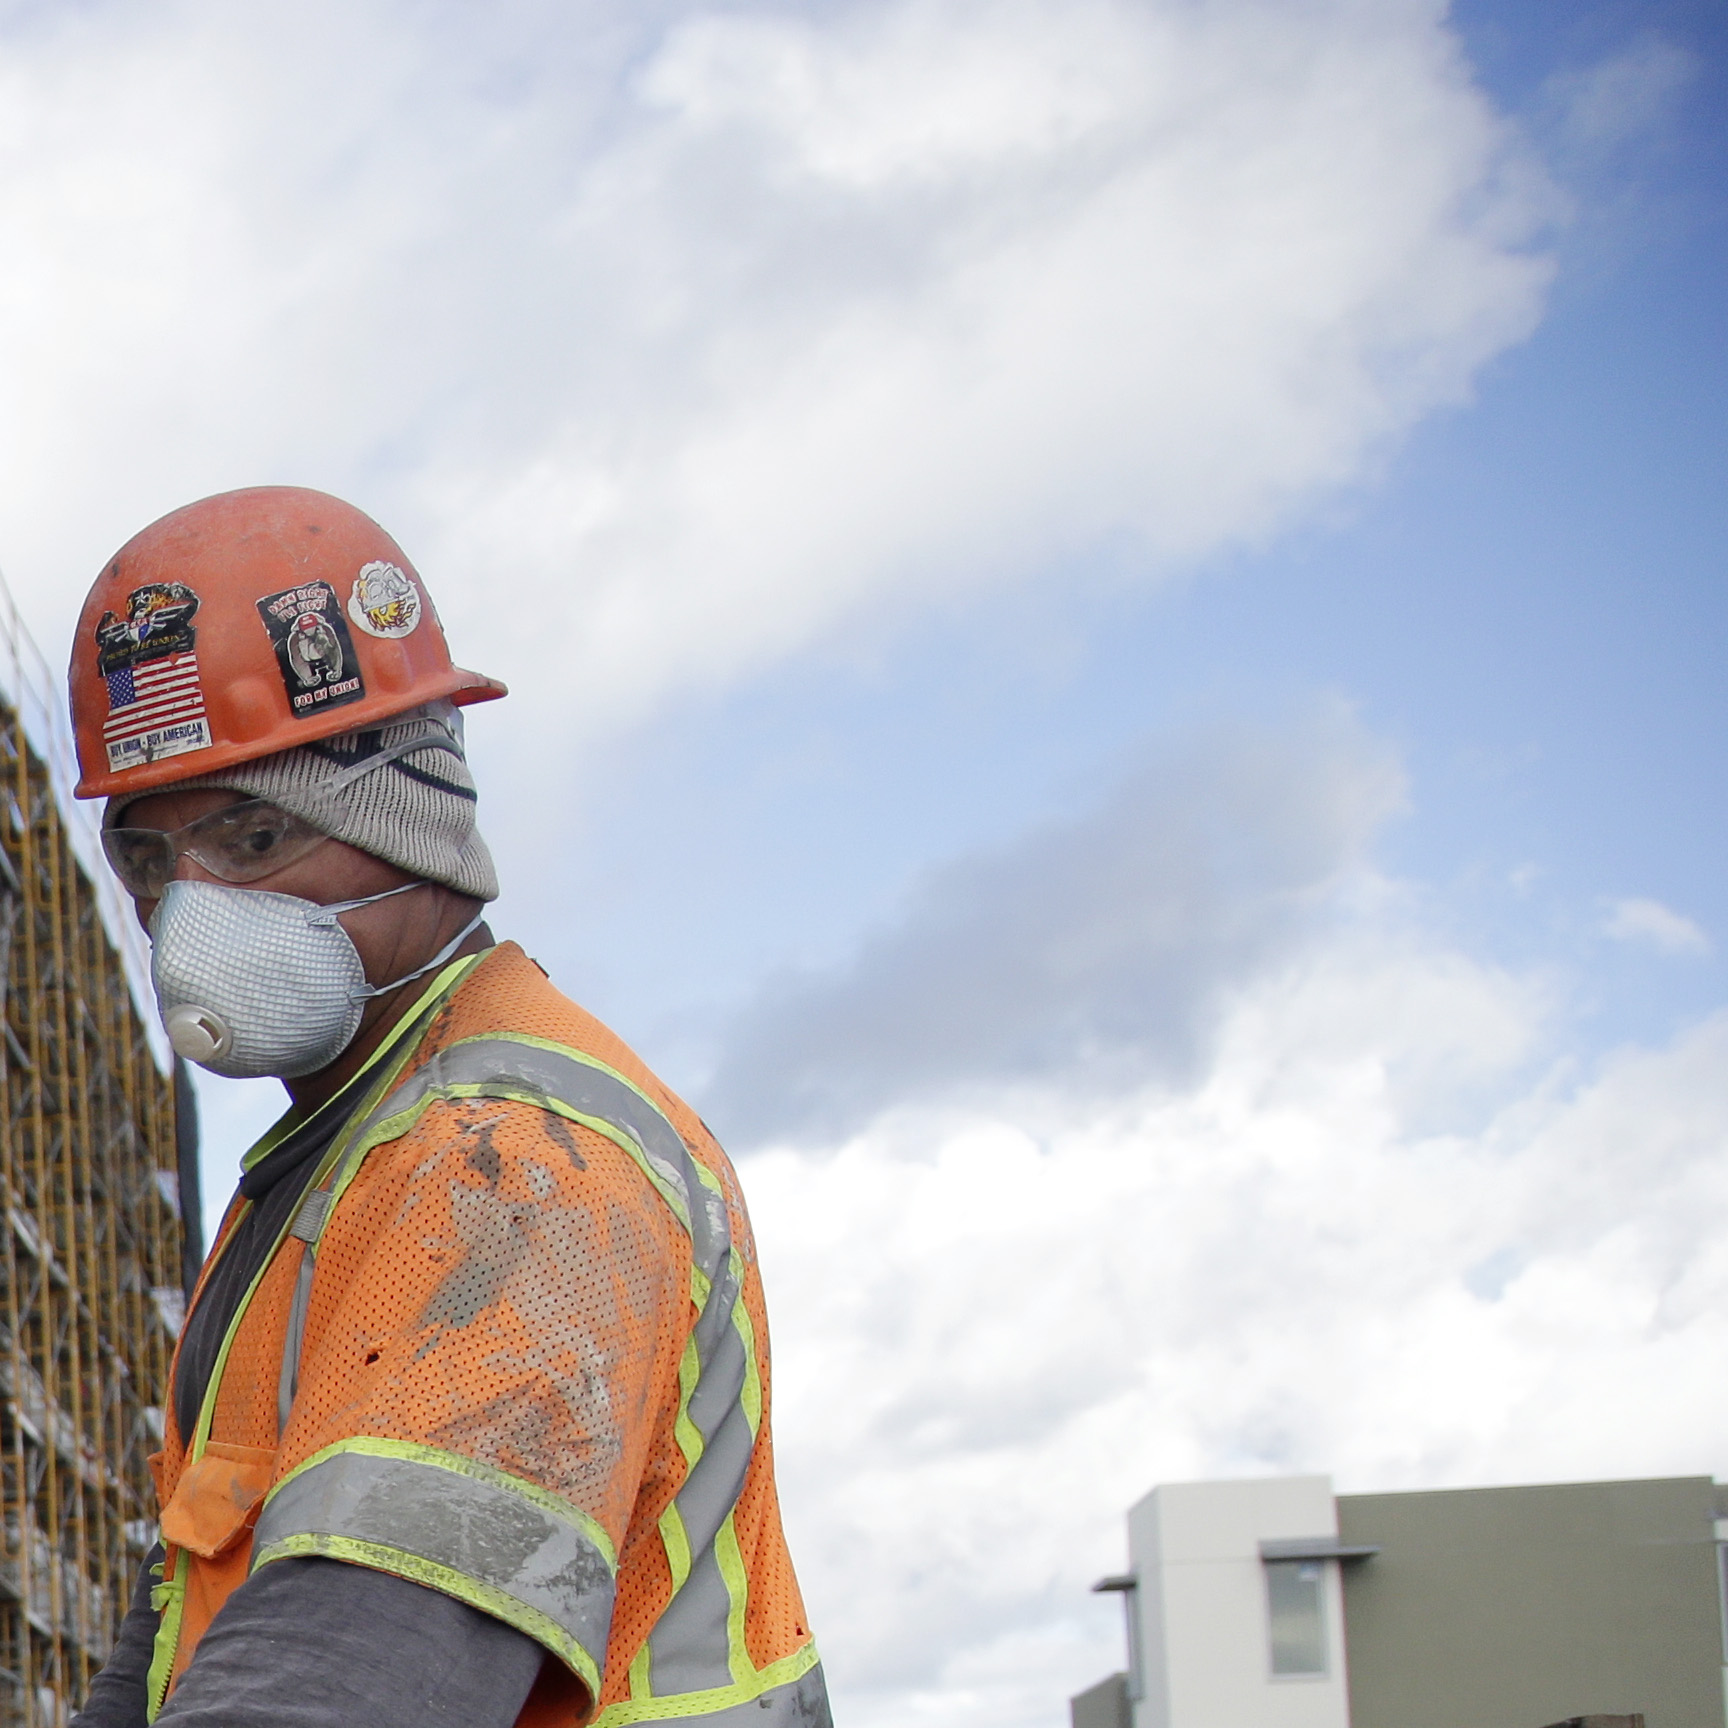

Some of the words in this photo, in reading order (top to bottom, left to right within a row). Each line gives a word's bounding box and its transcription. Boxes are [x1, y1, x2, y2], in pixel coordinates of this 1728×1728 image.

[294, 693, 313, 708] FOR
[314, 687, 328, 702] MY
[146, 732, 161, 746] BUY
[163, 722, 204, 742] AMERICAN
